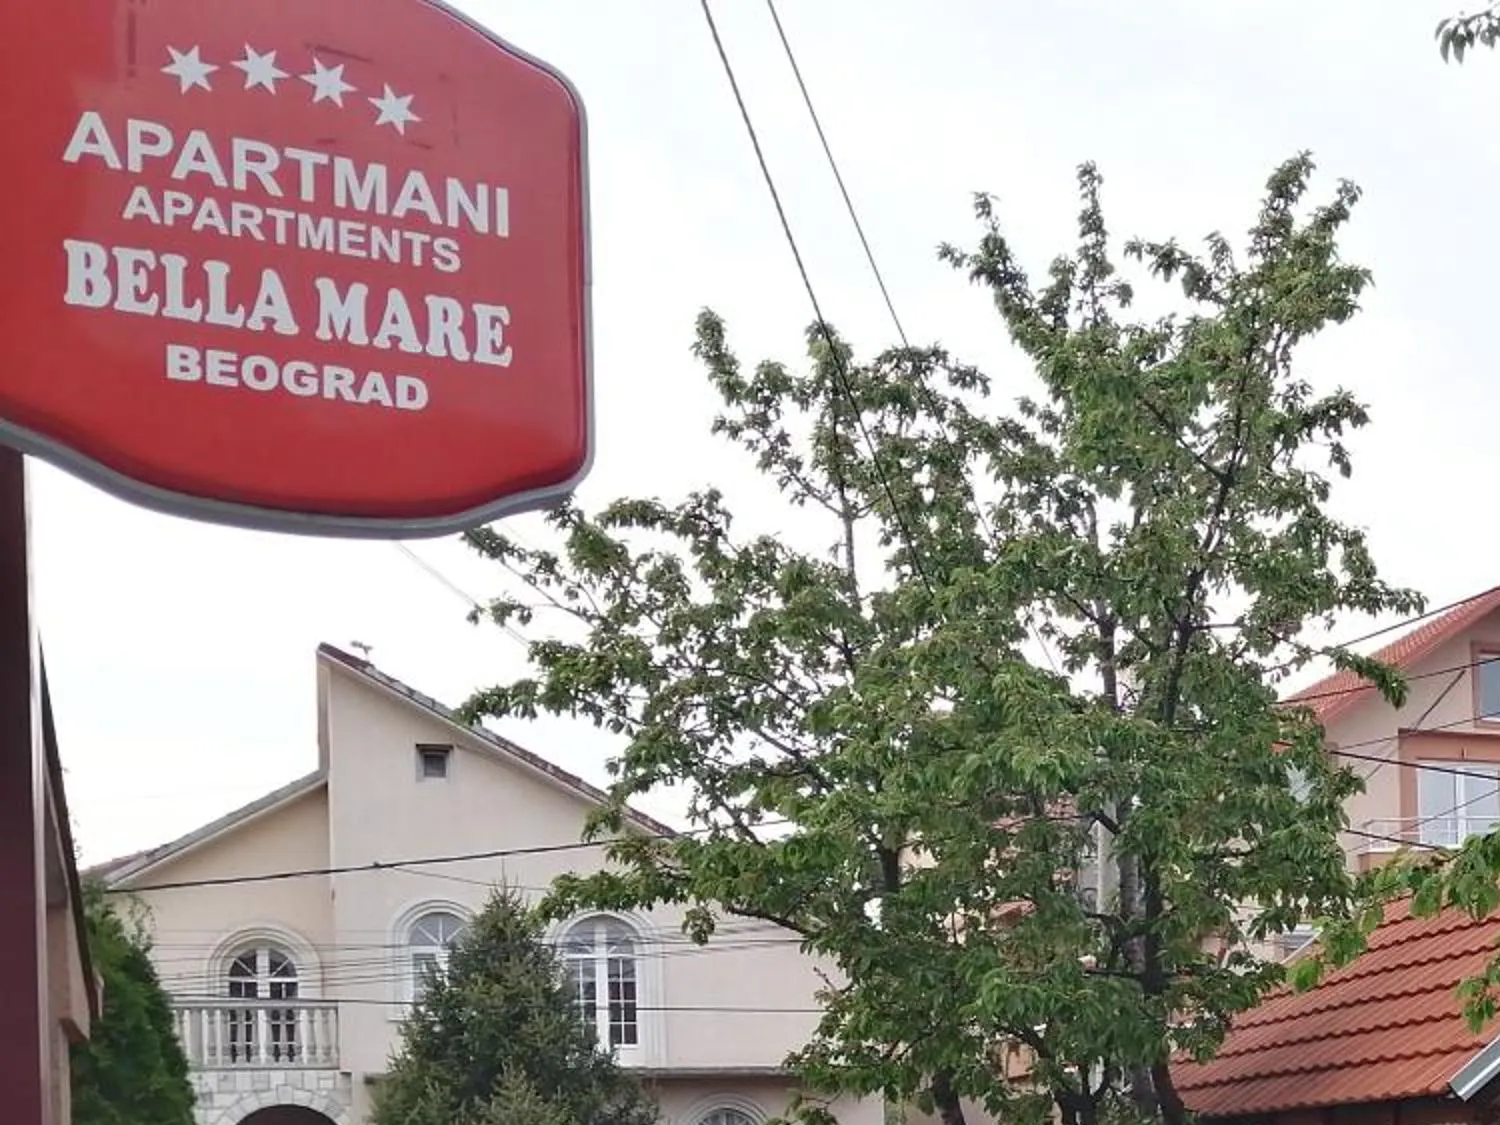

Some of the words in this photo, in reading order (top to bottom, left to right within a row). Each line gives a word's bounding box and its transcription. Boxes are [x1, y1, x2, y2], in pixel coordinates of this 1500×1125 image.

[63, 111, 510, 238] APARTMANI
[122, 186, 461, 273] APARTMENTS
[63, 239, 299, 335] BELLA
[315, 277, 513, 368] MARE
[166, 344, 430, 411] BEOGRAD
